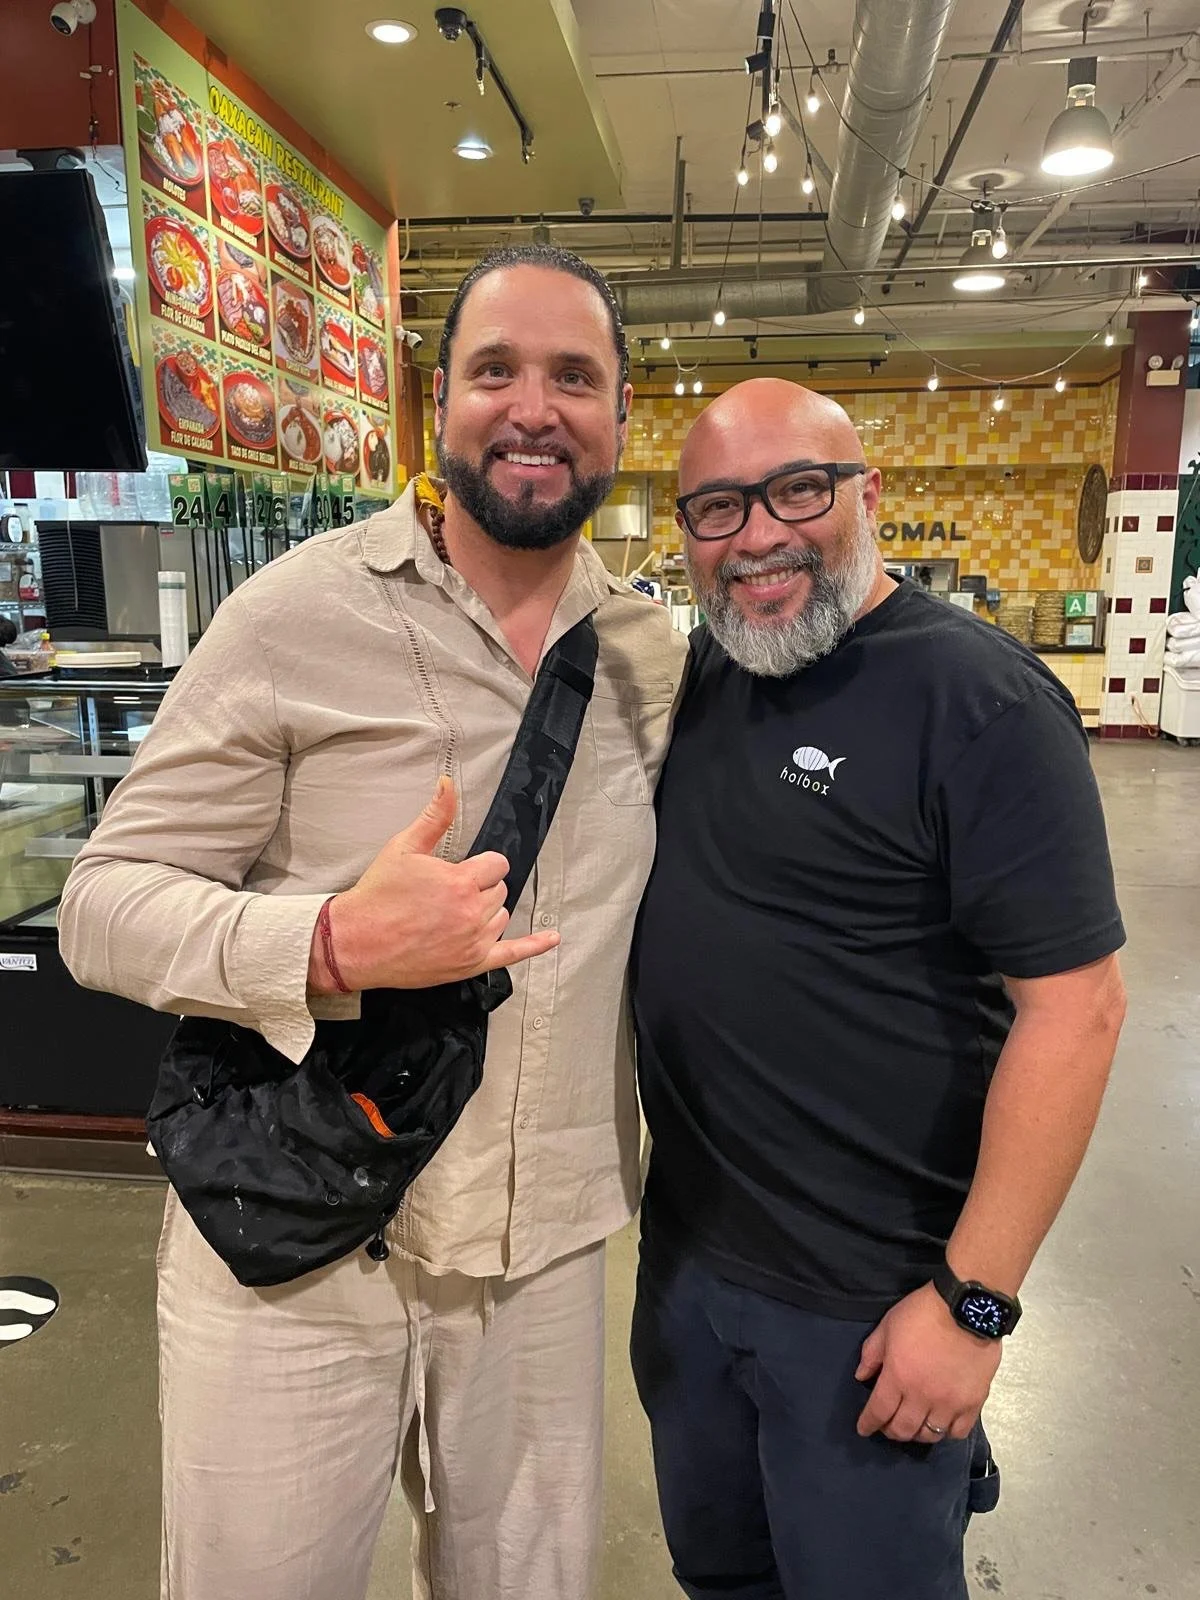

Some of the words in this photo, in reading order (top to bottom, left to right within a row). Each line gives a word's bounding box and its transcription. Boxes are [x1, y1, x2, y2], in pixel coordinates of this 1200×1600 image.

[208, 85, 273, 160] OAXACAN
[276, 141, 345, 219] RESTAURANT
[171, 431, 184, 446] FLOR
[184, 435, 191, 447] DE
[173, 495, 205, 526] 24
[878, 521, 966, 541] OMAL
[1069, 598, 1082, 613] A
[780, 766, 830, 796] holbox
